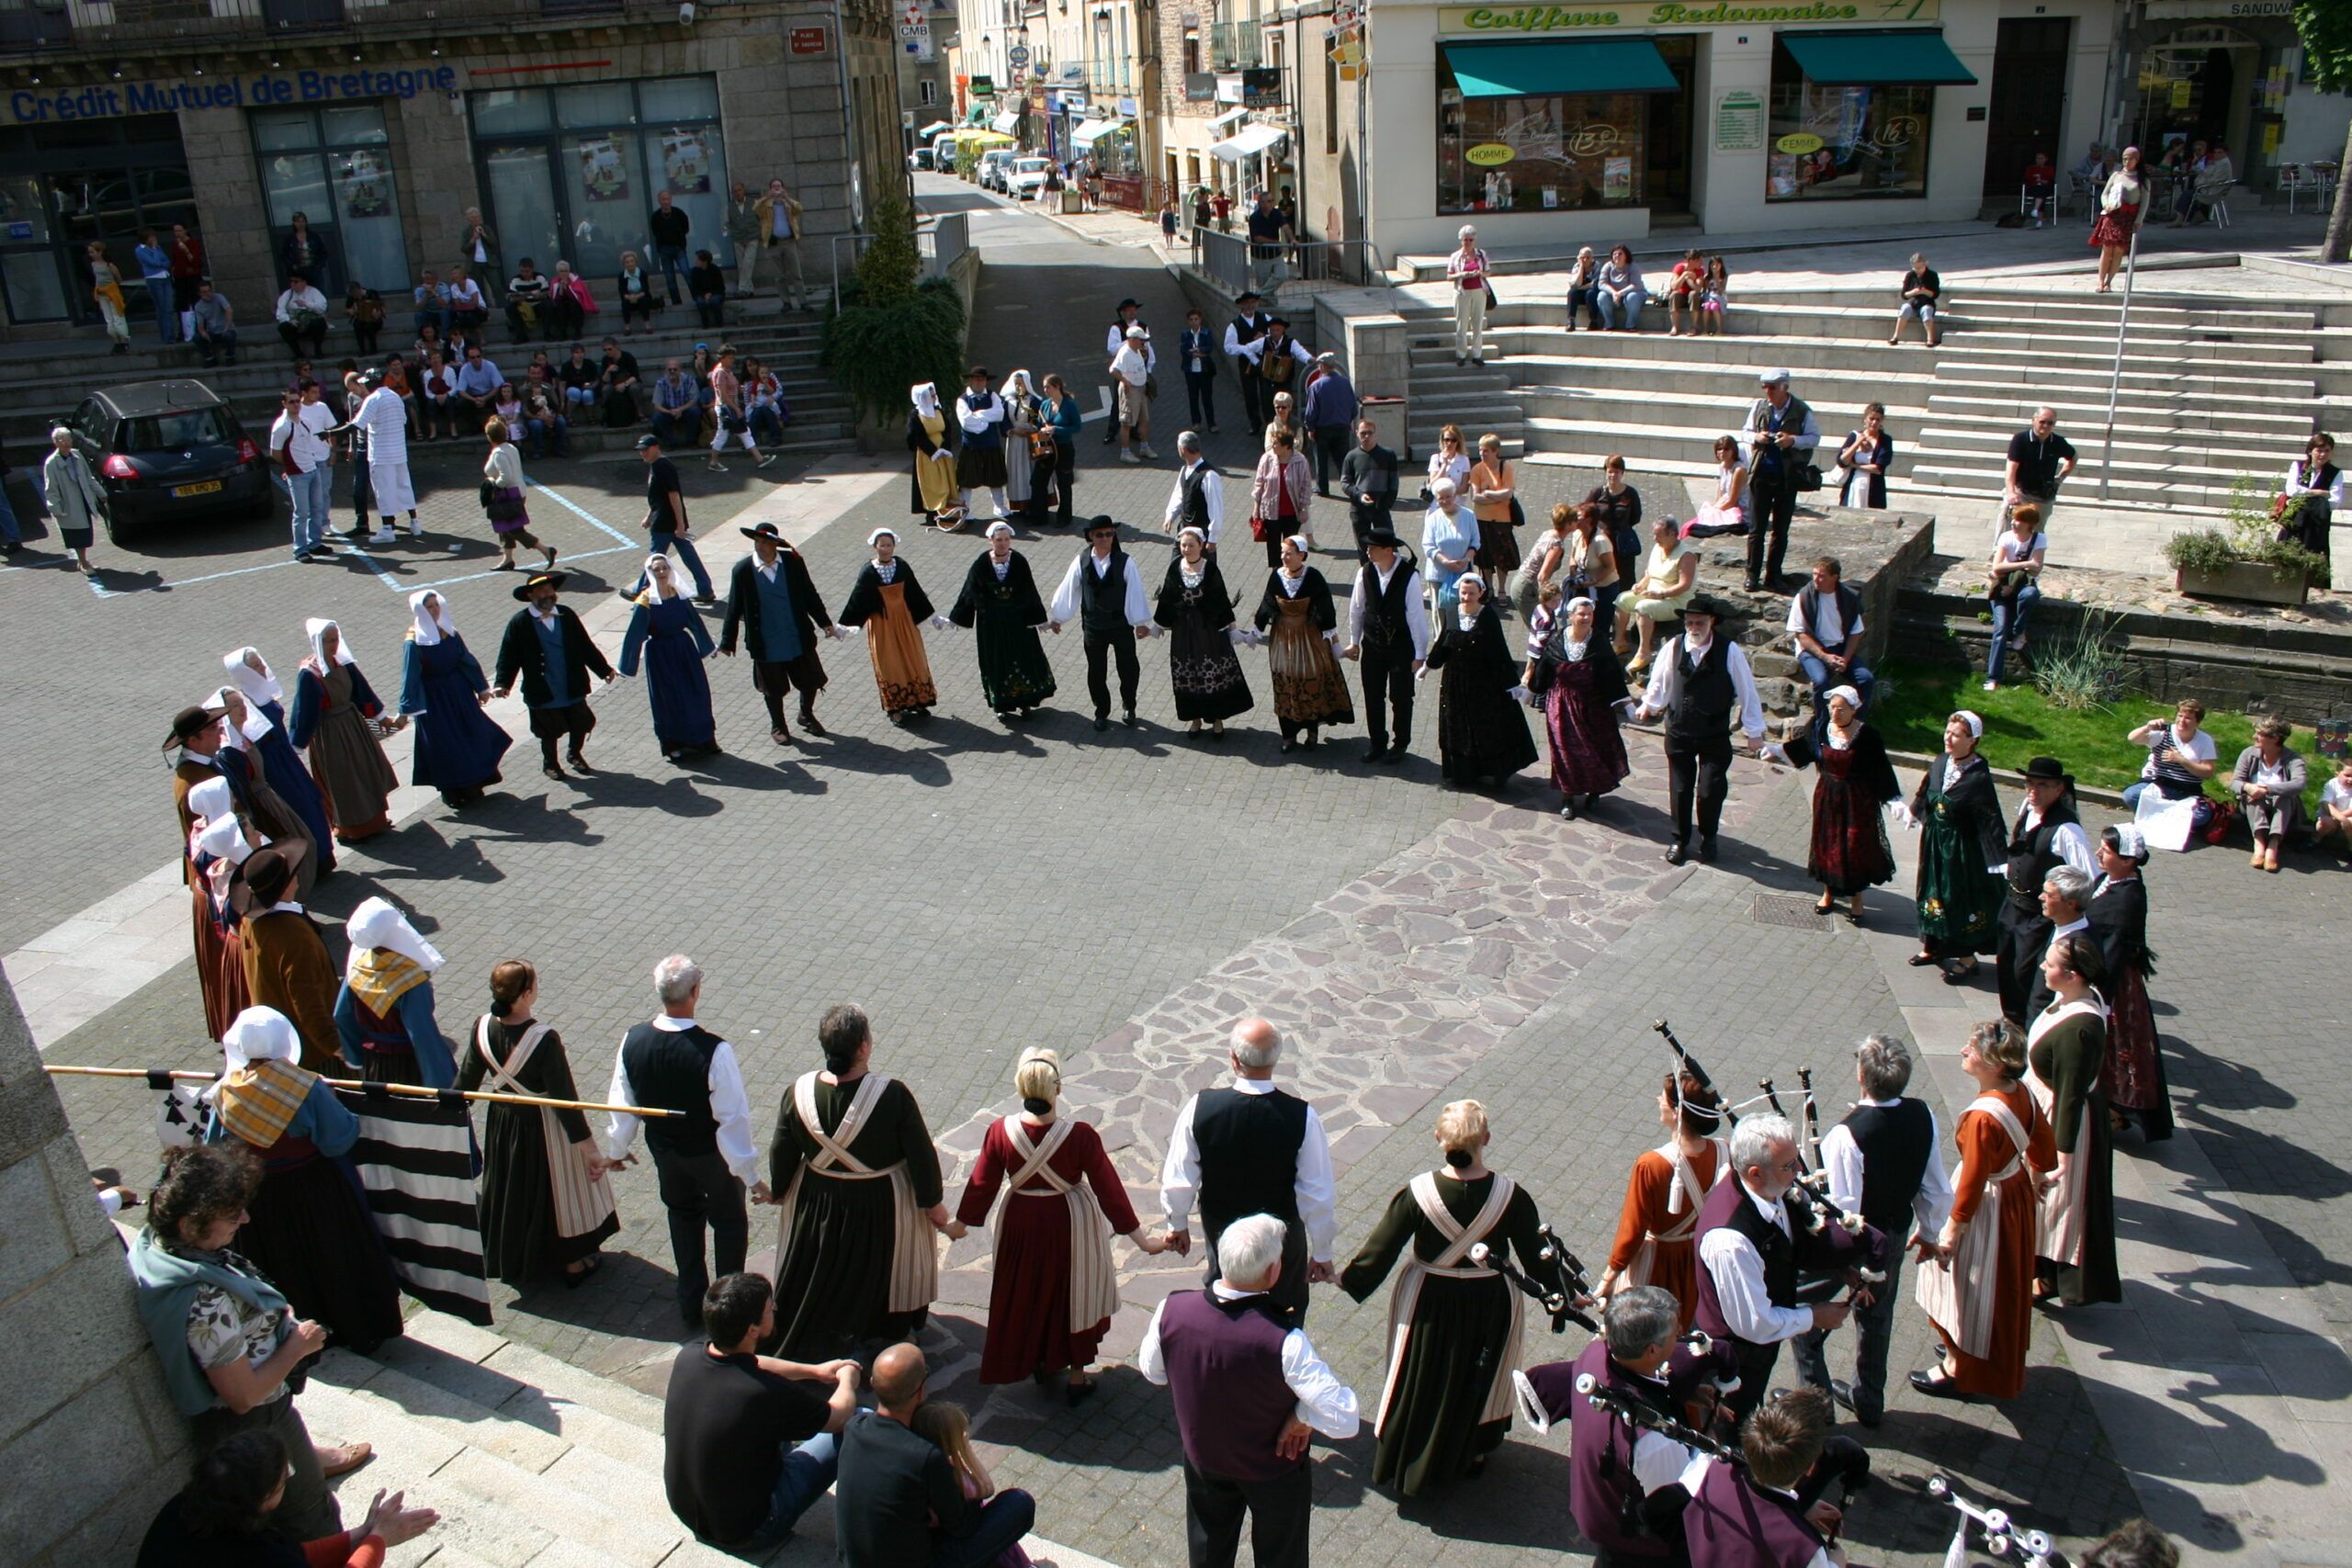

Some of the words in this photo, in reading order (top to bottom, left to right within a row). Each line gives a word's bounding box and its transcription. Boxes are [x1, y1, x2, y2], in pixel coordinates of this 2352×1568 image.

[1464, 6, 1620, 31] Coiffure
[1647, 2, 1858, 24] Redonnaise
[900, 26, 928, 36] CMB
[11, 85, 122, 121] Crédit
[126, 75, 243, 112] Mutuel
[251, 73, 293, 104] de
[298, 65, 458, 100] Bretagne
[1574, 131, 1596, 151] 13
[1883, 122, 1903, 141] 16
[1782, 139, 1816, 149] FEMME
[1471, 149, 1508, 160] HOMME
